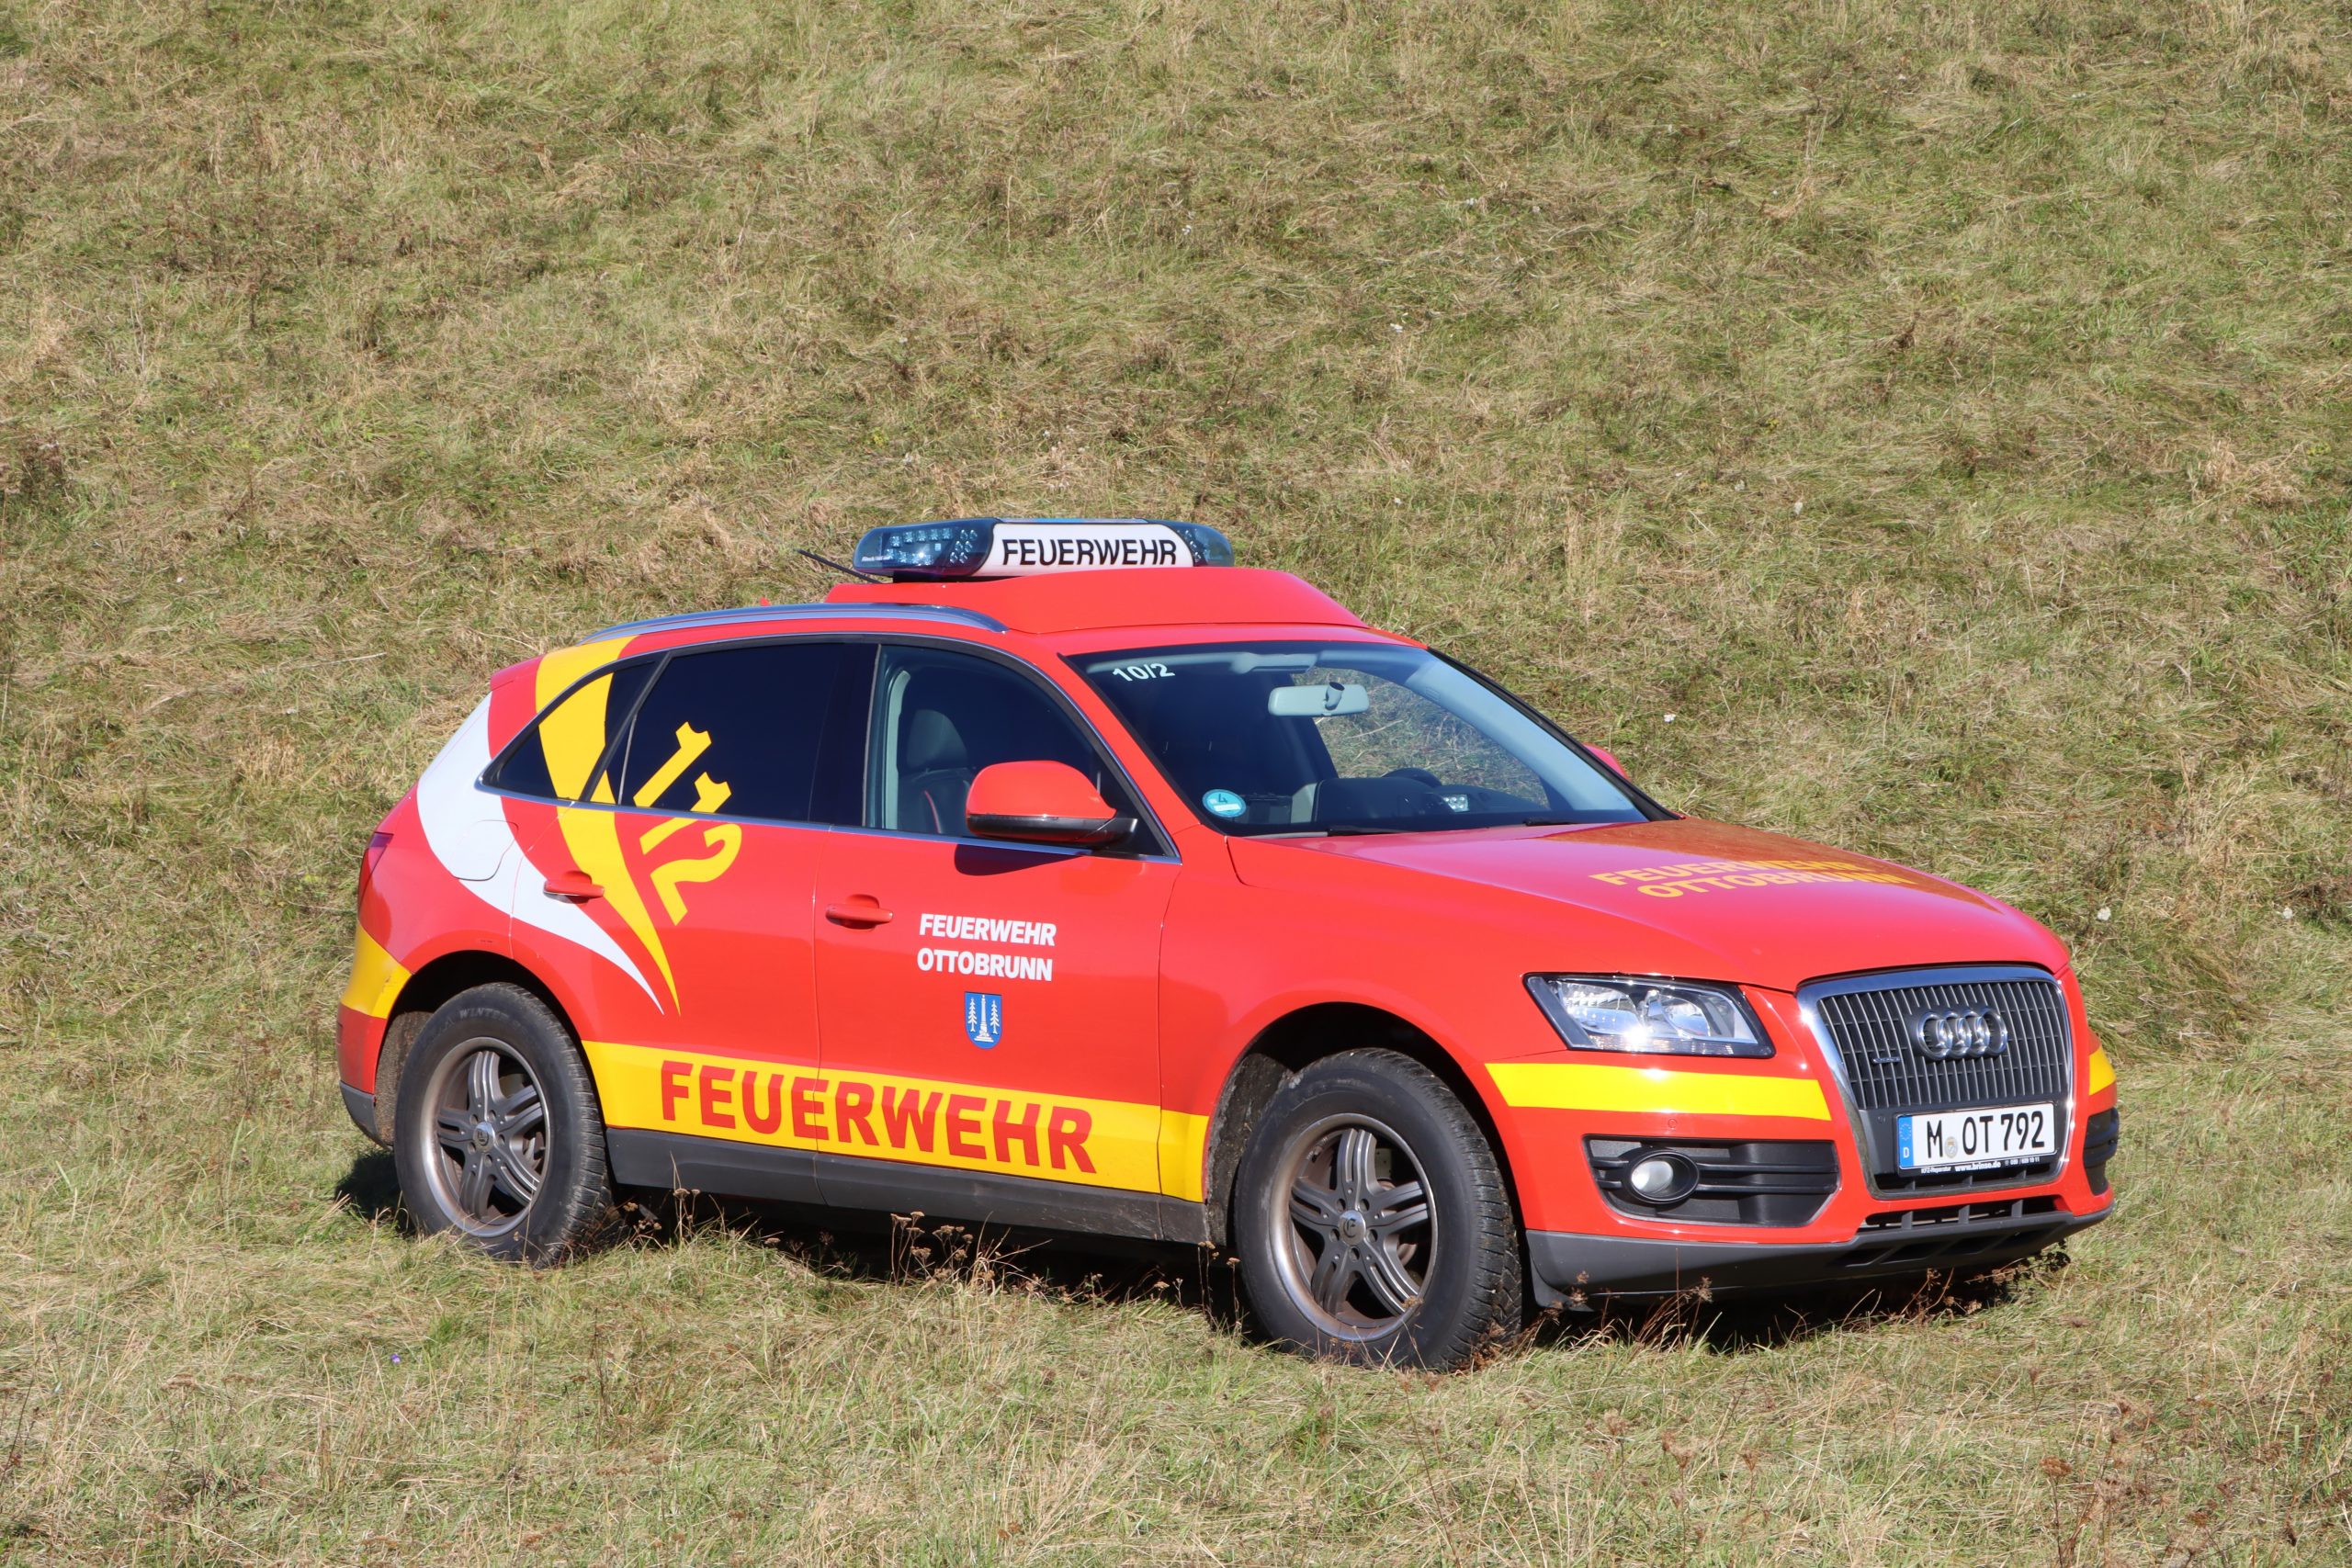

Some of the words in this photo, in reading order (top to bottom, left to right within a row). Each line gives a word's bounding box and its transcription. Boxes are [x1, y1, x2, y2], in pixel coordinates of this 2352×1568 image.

[1002, 539, 1176, 566] FEUERWEHR
[1113, 663, 1175, 681] 10/2
[633, 721, 742, 926] 112
[1589, 860, 1875, 886] FEUERWEHR
[1636, 871, 1917, 897] OTTOBRUNN
[920, 913, 1057, 946] FEUERWEHR
[917, 947, 1053, 981] OTTOBRUNN
[661, 1060, 1097, 1174] FEUERWEHR
[1903, 1147, 1910, 1158] D
[1927, 1120, 1944, 1158] M
[1962, 1114, 1994, 1155] OT
[2000, 1111, 2045, 1152] 792
